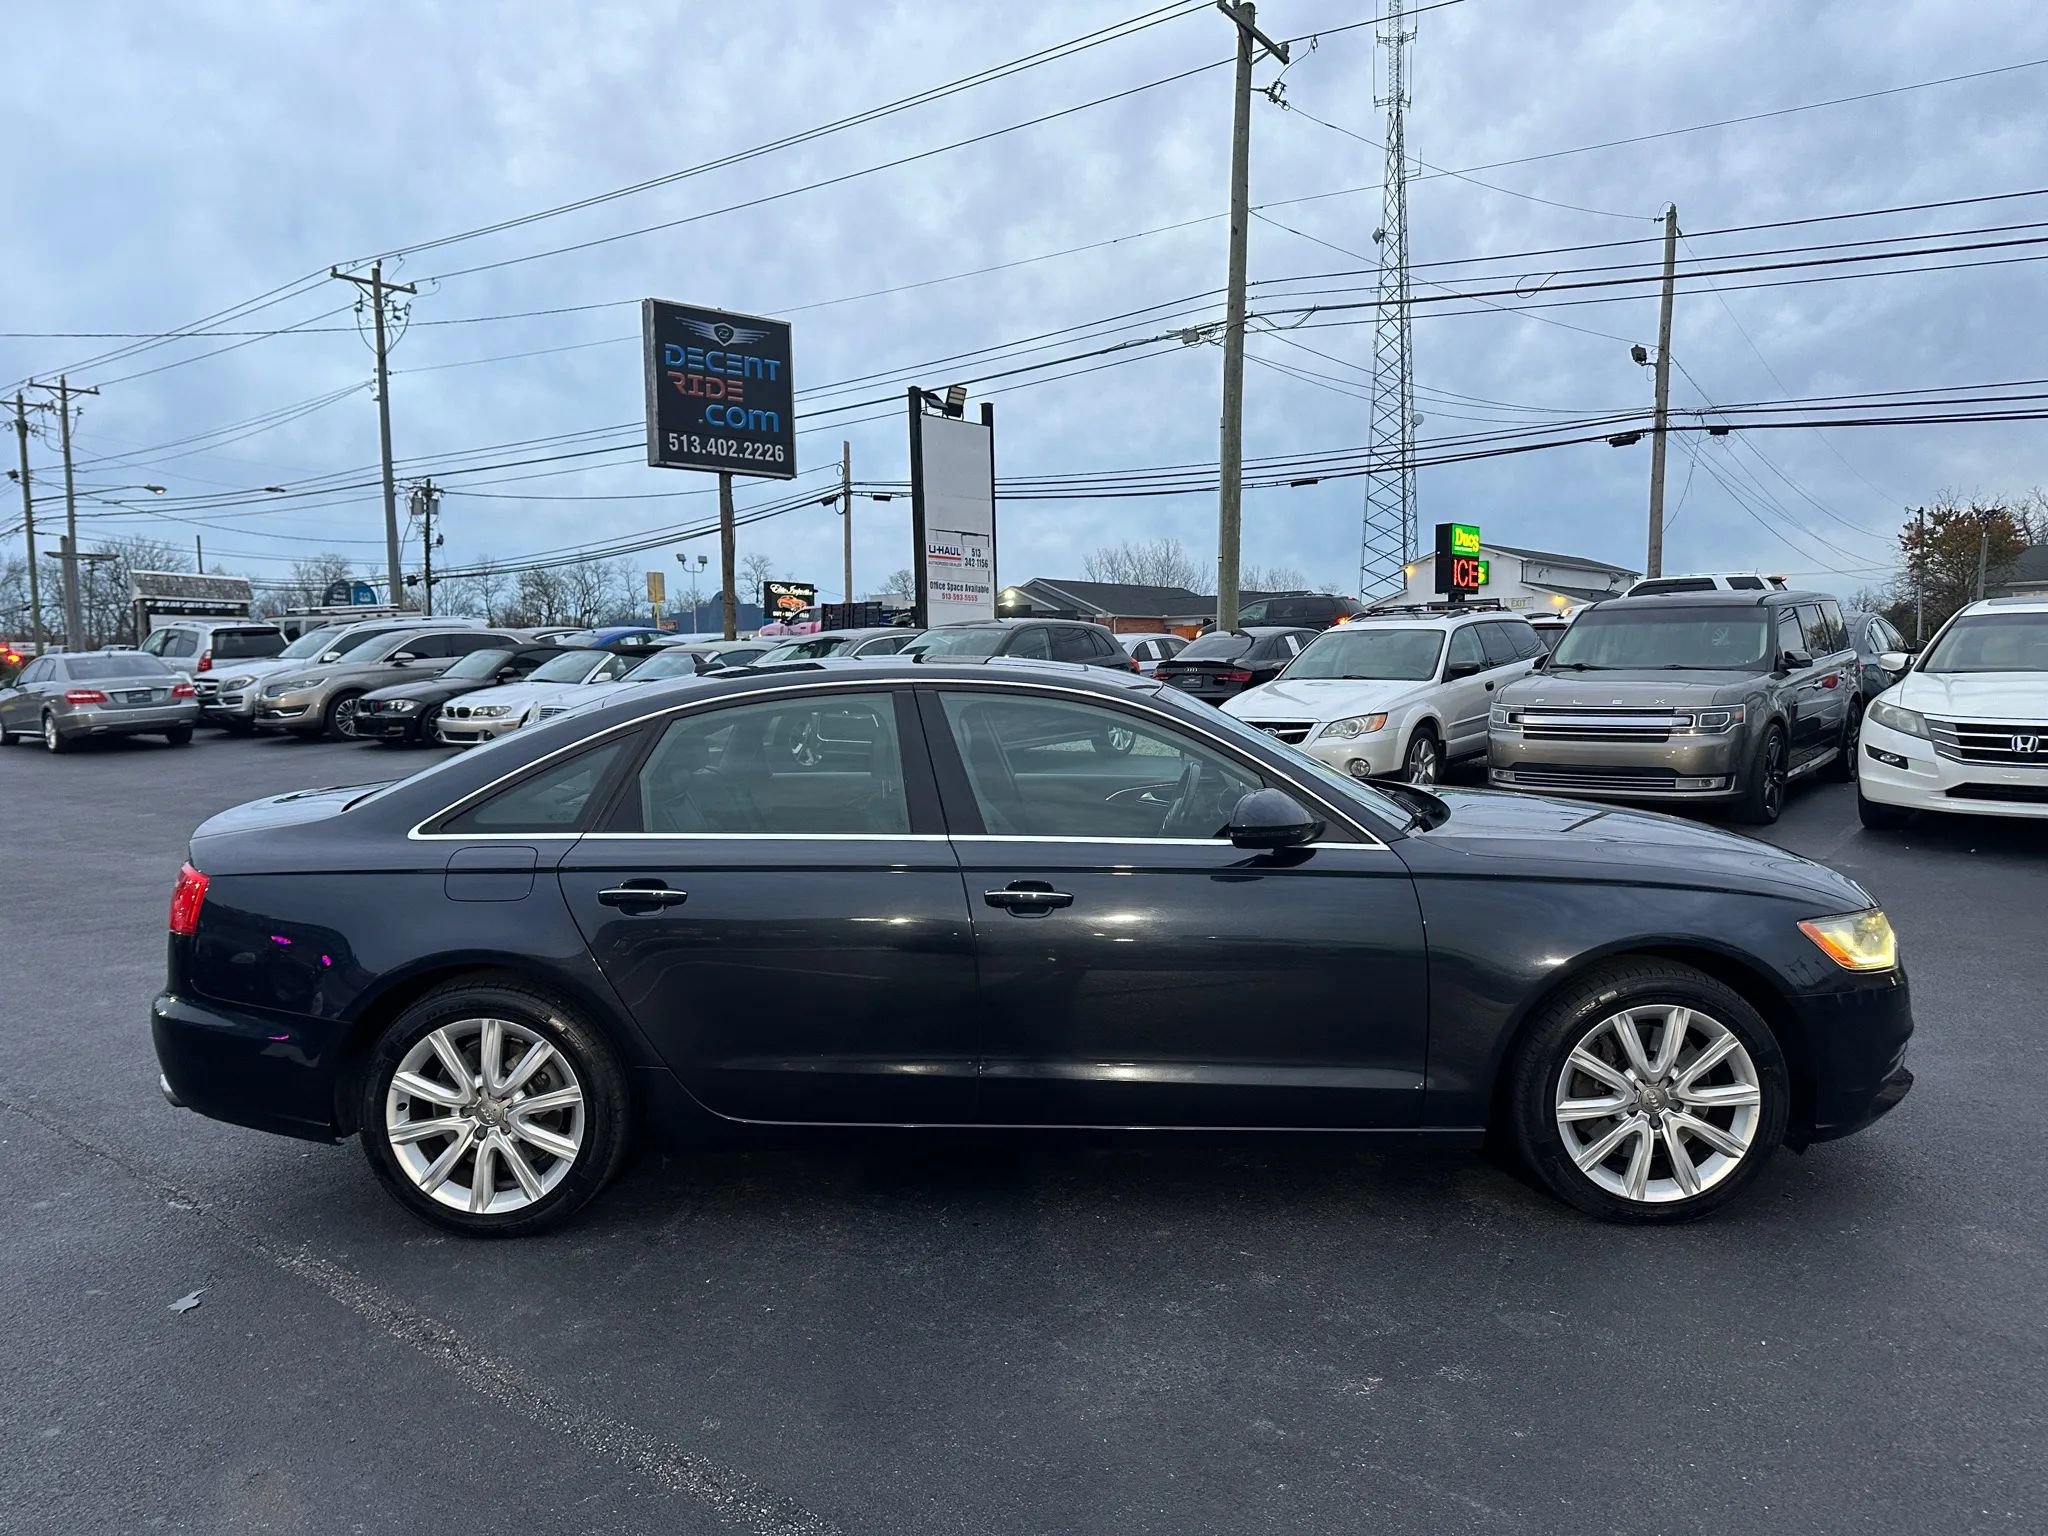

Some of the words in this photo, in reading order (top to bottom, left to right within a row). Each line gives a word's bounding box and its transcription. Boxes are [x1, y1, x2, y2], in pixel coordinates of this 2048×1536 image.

[664, 343, 781, 381] DECENT
[667, 370, 744, 402] RIDE
[668, 433, 785, 462] 513.402.2226
[929, 545, 961, 556] U-HAUL
[972, 548, 981, 557] 513
[1454, 560, 1478, 586] ICE
[930, 581, 945, 590] Office
[947, 582, 963, 592] Space
[965, 584, 989, 593] Available
